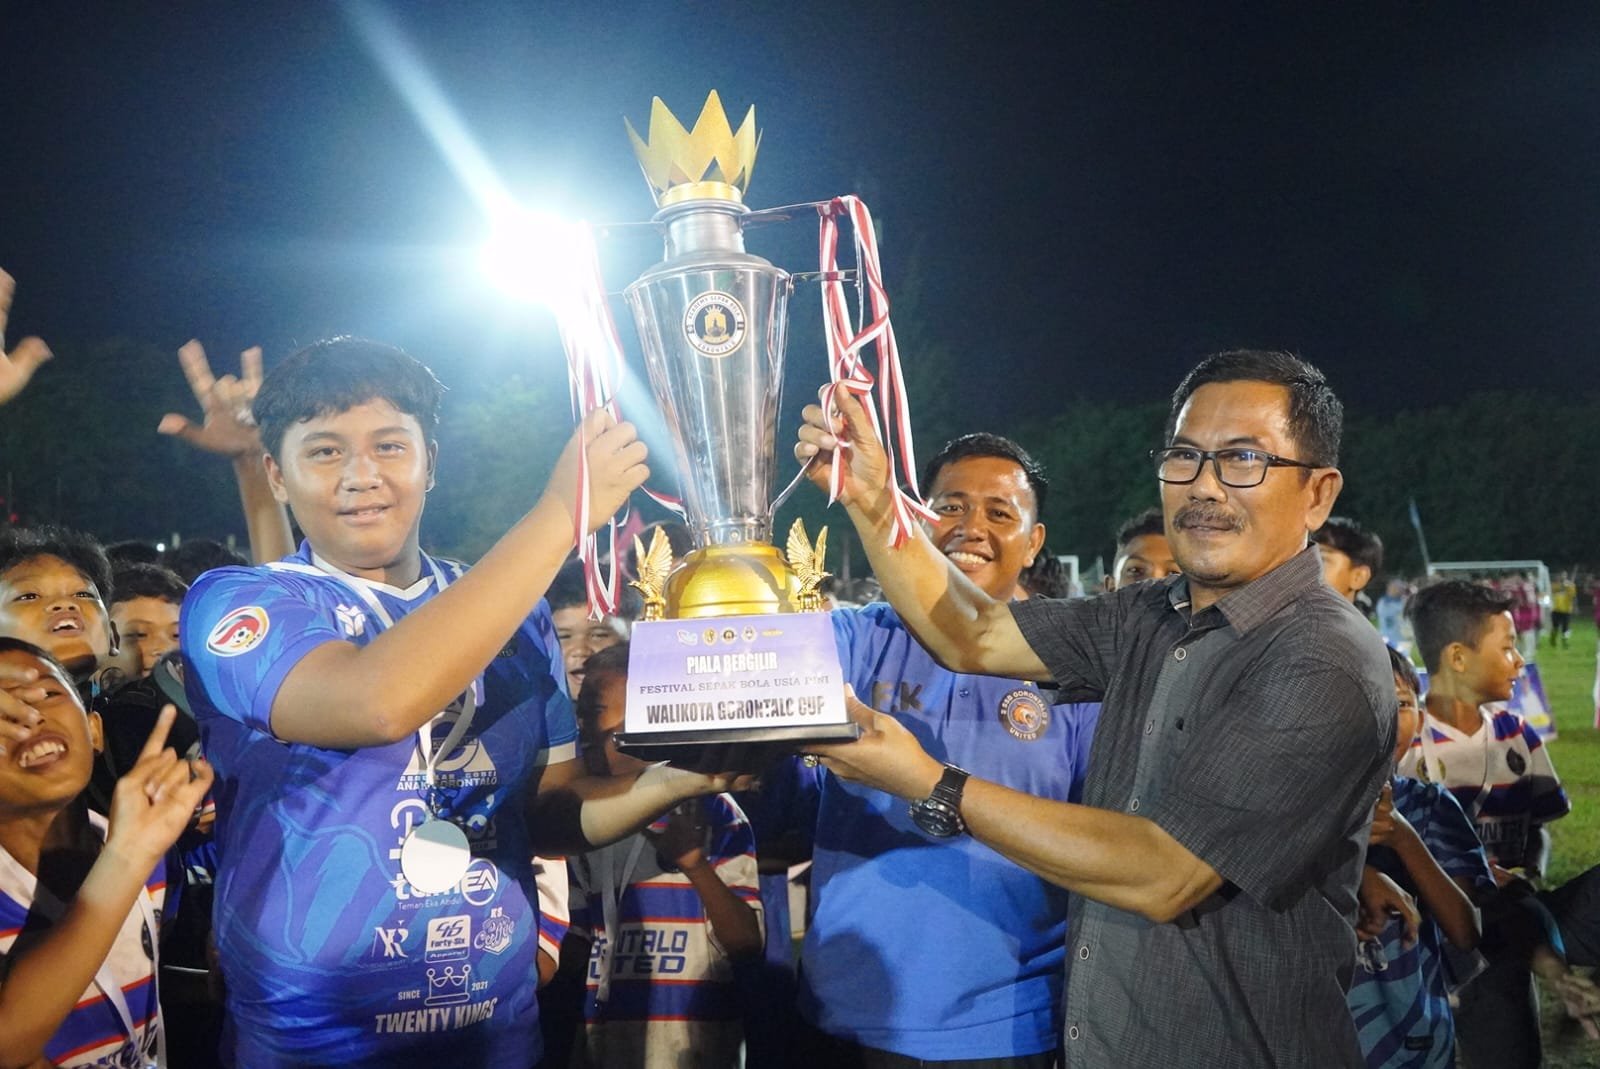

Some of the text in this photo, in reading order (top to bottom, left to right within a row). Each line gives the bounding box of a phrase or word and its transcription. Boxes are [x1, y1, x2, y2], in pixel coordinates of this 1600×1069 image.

[687, 652, 778, 674] PIALA BERGILIR
[639, 683, 695, 695] FESTIVAL
[698, 681, 736, 691] SEPAK
[740, 679, 770, 689] BOLA
[774, 677, 801, 687] USIA
[647, 702, 714, 724] WALIKOTA
[798, 696, 826, 716] CUP
[1009, 727, 1037, 740] UNITED
[432, 776, 498, 790] ORONTALO
[398, 981, 489, 1000] SINCE 2021
[375, 997, 498, 1033] TWENTY KINGS
